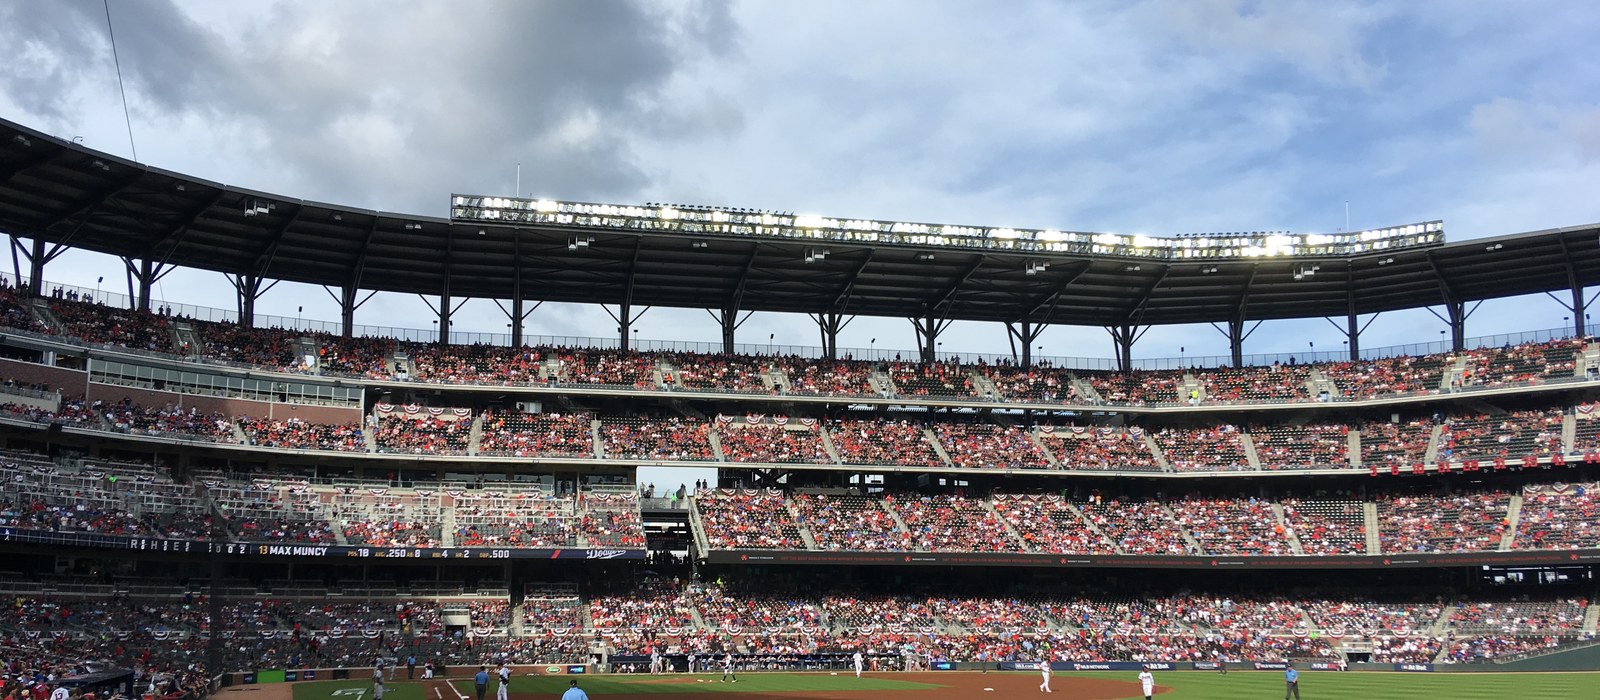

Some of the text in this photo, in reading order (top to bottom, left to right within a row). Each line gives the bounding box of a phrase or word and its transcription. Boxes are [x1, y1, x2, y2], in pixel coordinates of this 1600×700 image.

[1412, 464, 1424, 474] 10
[1438, 462, 1450, 472] 21
[131, 539, 179, 550] R H E
[259, 545, 268, 554] 13
[270, 546, 291, 555] MAX
[293, 547, 327, 556] MUNCY
[386, 549, 406, 557] .250
[415, 549, 420, 557] 8
[442, 550, 448, 558] 4
[464, 550, 470, 558] 2
[490, 550, 509, 558] .500
